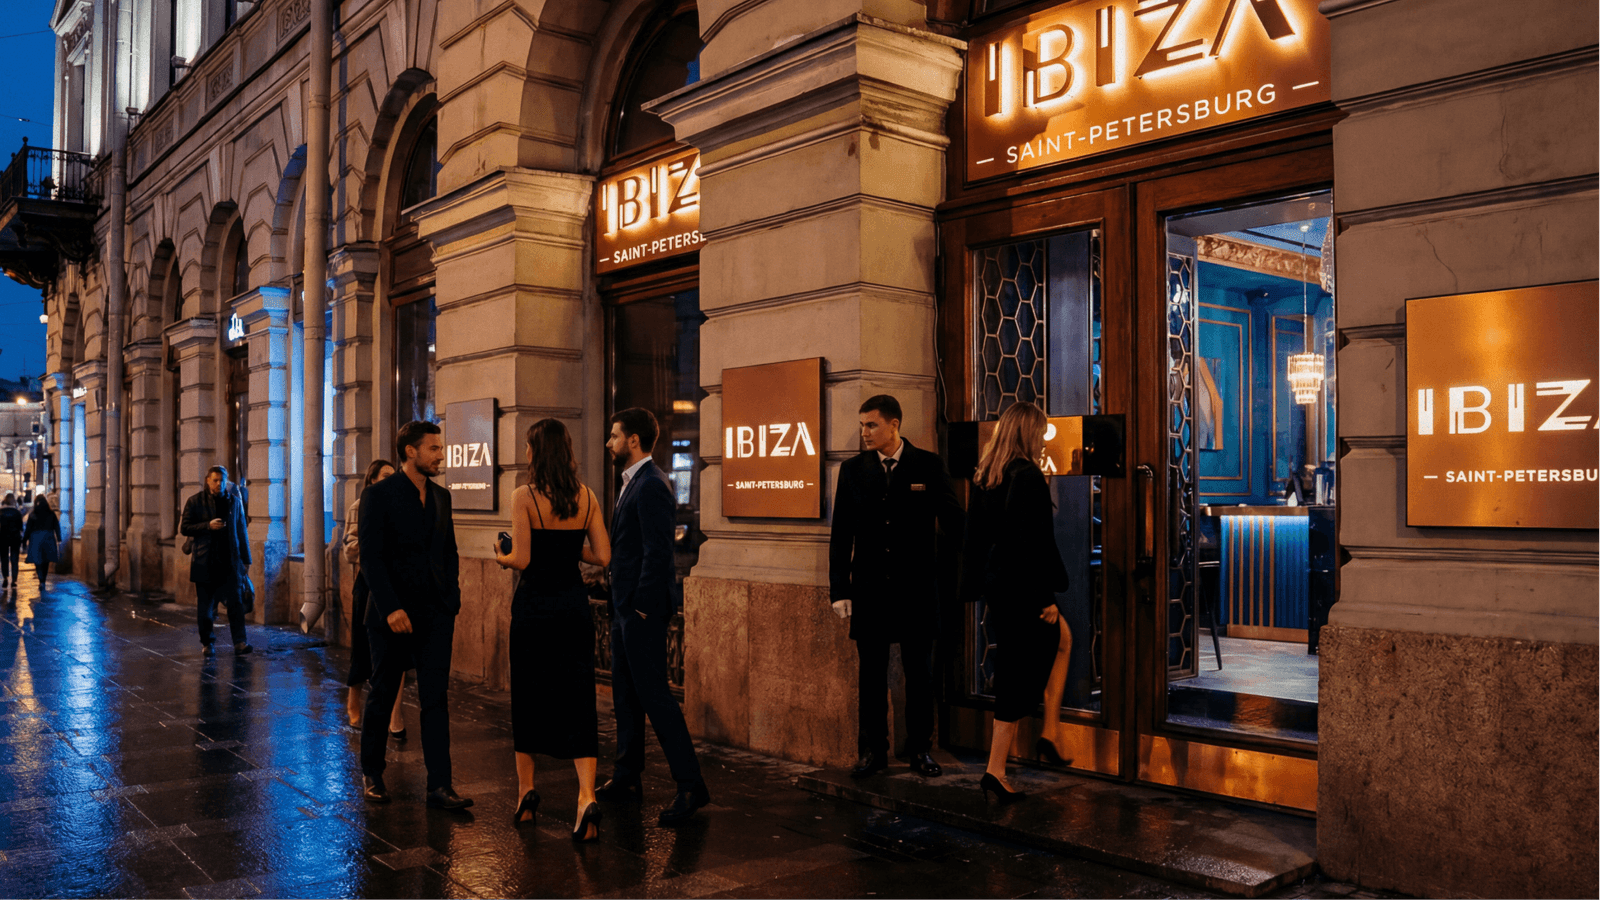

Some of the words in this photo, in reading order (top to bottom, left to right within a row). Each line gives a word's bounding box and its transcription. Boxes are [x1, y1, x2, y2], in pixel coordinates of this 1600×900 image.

[984, 0, 1296, 118] IBIZA
[1006, 83, 1277, 164] SAINT-PETERSBURG
[1417, 379, 1600, 436] IBIZ
[446, 442, 492, 468] IBIZA
[725, 421, 816, 459] IBIZA
[735, 480, 804, 490] SAINT-PETERSBURG
